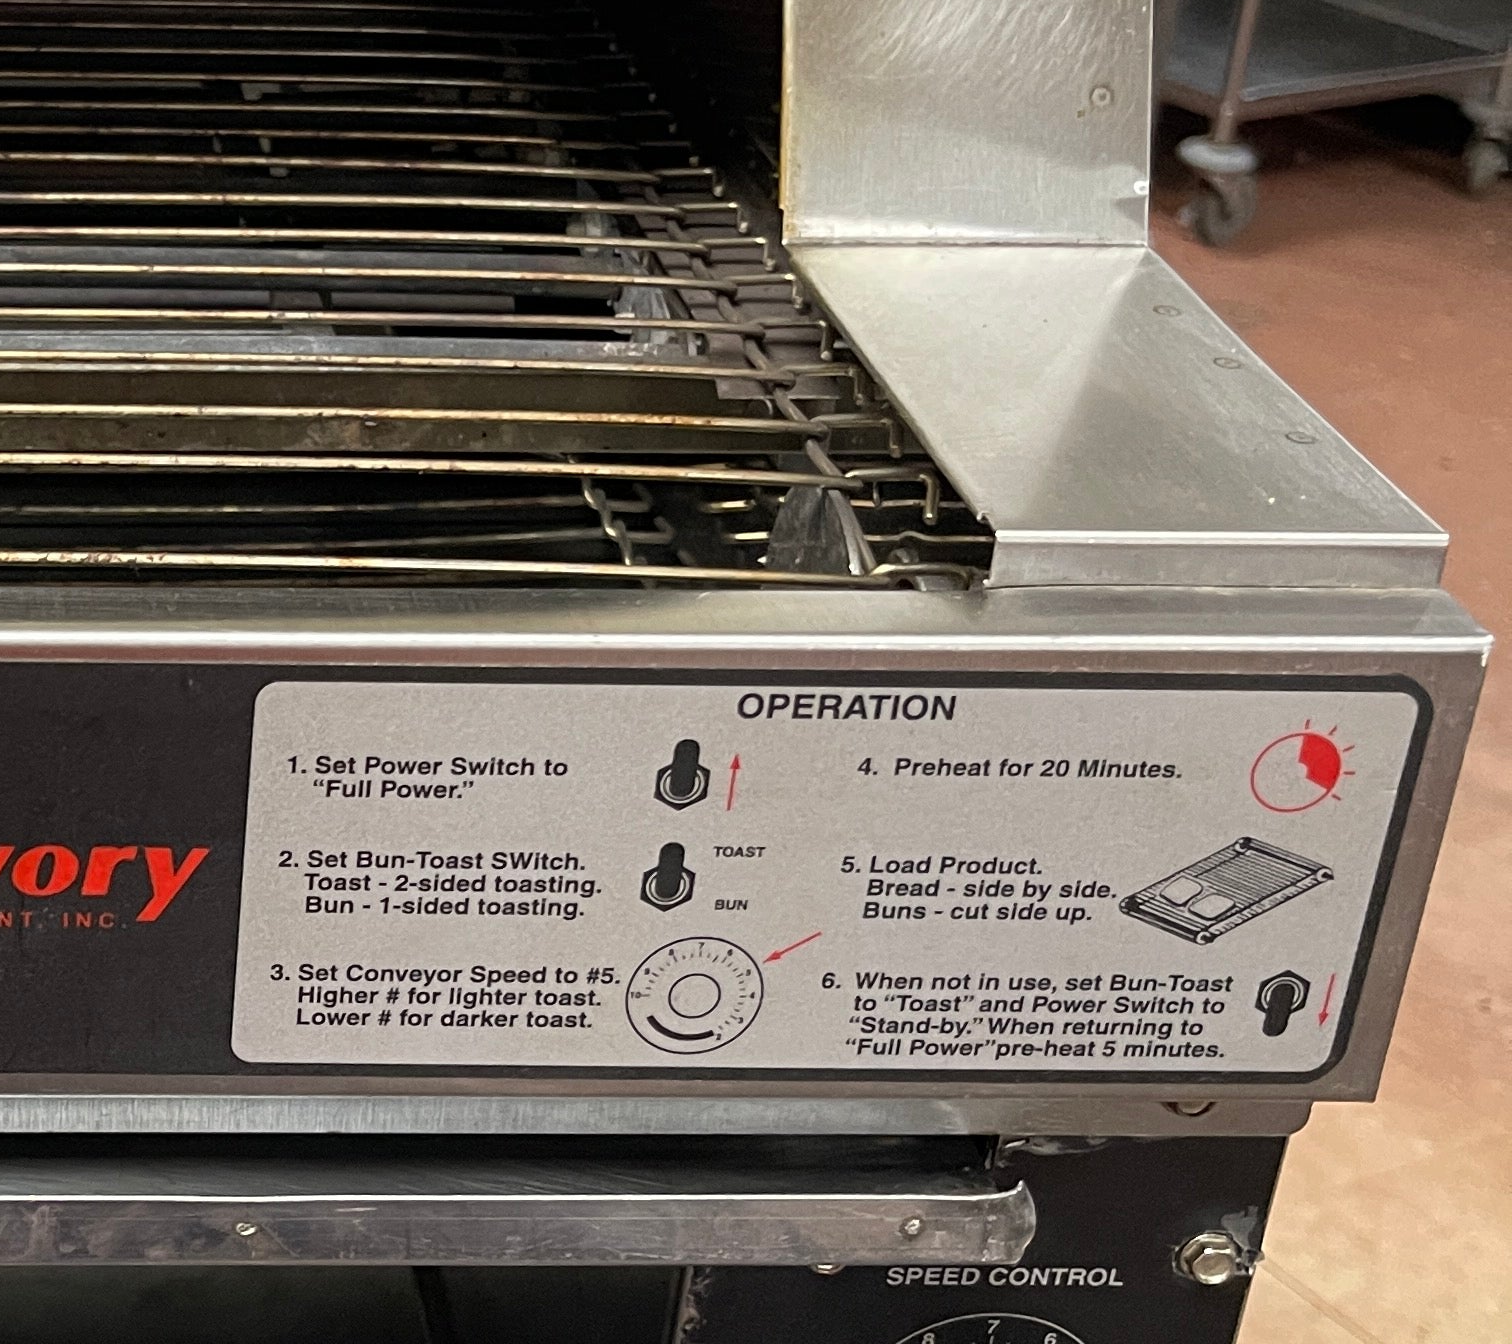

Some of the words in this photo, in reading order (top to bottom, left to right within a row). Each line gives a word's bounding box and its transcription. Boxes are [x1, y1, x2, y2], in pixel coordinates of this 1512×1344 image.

[738, 693, 956, 720] OPERATION
[288, 756, 306, 773] 1.
[315, 756, 356, 774] Set
[365, 757, 442, 775] Power
[451, 757, 534, 775] Switch
[545, 760, 567, 776] to
[858, 758, 877, 775] 4.
[895, 758, 990, 776] Preheat
[1000, 759, 1033, 776] for
[1040, 760, 1069, 777] 20
[1078, 760, 1181, 778] Minutes.
[279, 851, 298, 867] 2.
[307, 850, 347, 868] Set
[357, 851, 483, 869] Bun-Toast
[491, 852, 585, 870] SWitch.
[714, 846, 766, 857] TOAST
[841, 856, 860, 873] 5.
[870, 856, 931, 873] Load
[939, 857, 1042, 874] Product.
[304, 873, 371, 891] Toast
[395, 874, 486, 892] 2-sided
[495, 876, 601, 898] toasting.
[867, 879, 940, 896] Bread
[963, 880, 1014, 897] side
[1023, 880, 1052, 902] by
[1059, 880, 1116, 898] side.
[306, 896, 353, 913] Bun
[380, 897, 469, 914] 1-sided
[478, 898, 584, 920] toasting.
[715, 899, 748, 910] BUN
[863, 902, 926, 919] Buns
[951, 904, 989, 919] cut
[996, 903, 1047, 920] side
[1056, 908, 1091, 925] up.
[63, 910, 127, 930] INC.
[271, 964, 290, 980] 3.
[299, 964, 338, 981] Set
[347, 965, 462, 986] Conveyor
[470, 966, 546, 987] Speed
[555, 968, 578, 983] to
[587, 968, 620, 984] #5.
[822, 973, 840, 988] 6.
[856, 972, 922, 989] When
[931, 974, 971, 990] not
[979, 973, 999, 990] in
[1009, 978, 1056, 994] use,
[1065, 975, 1102, 991] set
[1110, 975, 1233, 992] Bun-Toast
[299, 986, 379, 1008] Higher
[386, 988, 400, 1004] #
[408, 987, 441, 1004] for
[449, 988, 527, 1009] lighter
[535, 990, 601, 1006] toast.
[855, 996, 876, 1011] to
[979, 996, 1024, 1012] and
[1032, 996, 1107, 1013] Power
[1114, 997, 1193, 1014] Switch
[1203, 998, 1224, 1014] to
[297, 1008, 371, 1025] Lower
[378, 1010, 391, 1026] #
[400, 1009, 433, 1026] for
[441, 1010, 518, 1027] darker
[527, 1012, 592, 1028] toast.
[989, 1018, 1054, 1034] When
[1063, 1019, 1172, 1040] returning
[1181, 1020, 1203, 1035] to
[1102, 1041, 1116, 1057] 5
[1123, 1041, 1224, 1057] minutes.
[887, 1268, 980, 1285] SPEED
[989, 1268, 1123, 1286] CONTROL
[988, 1320, 1000, 1333] 7
